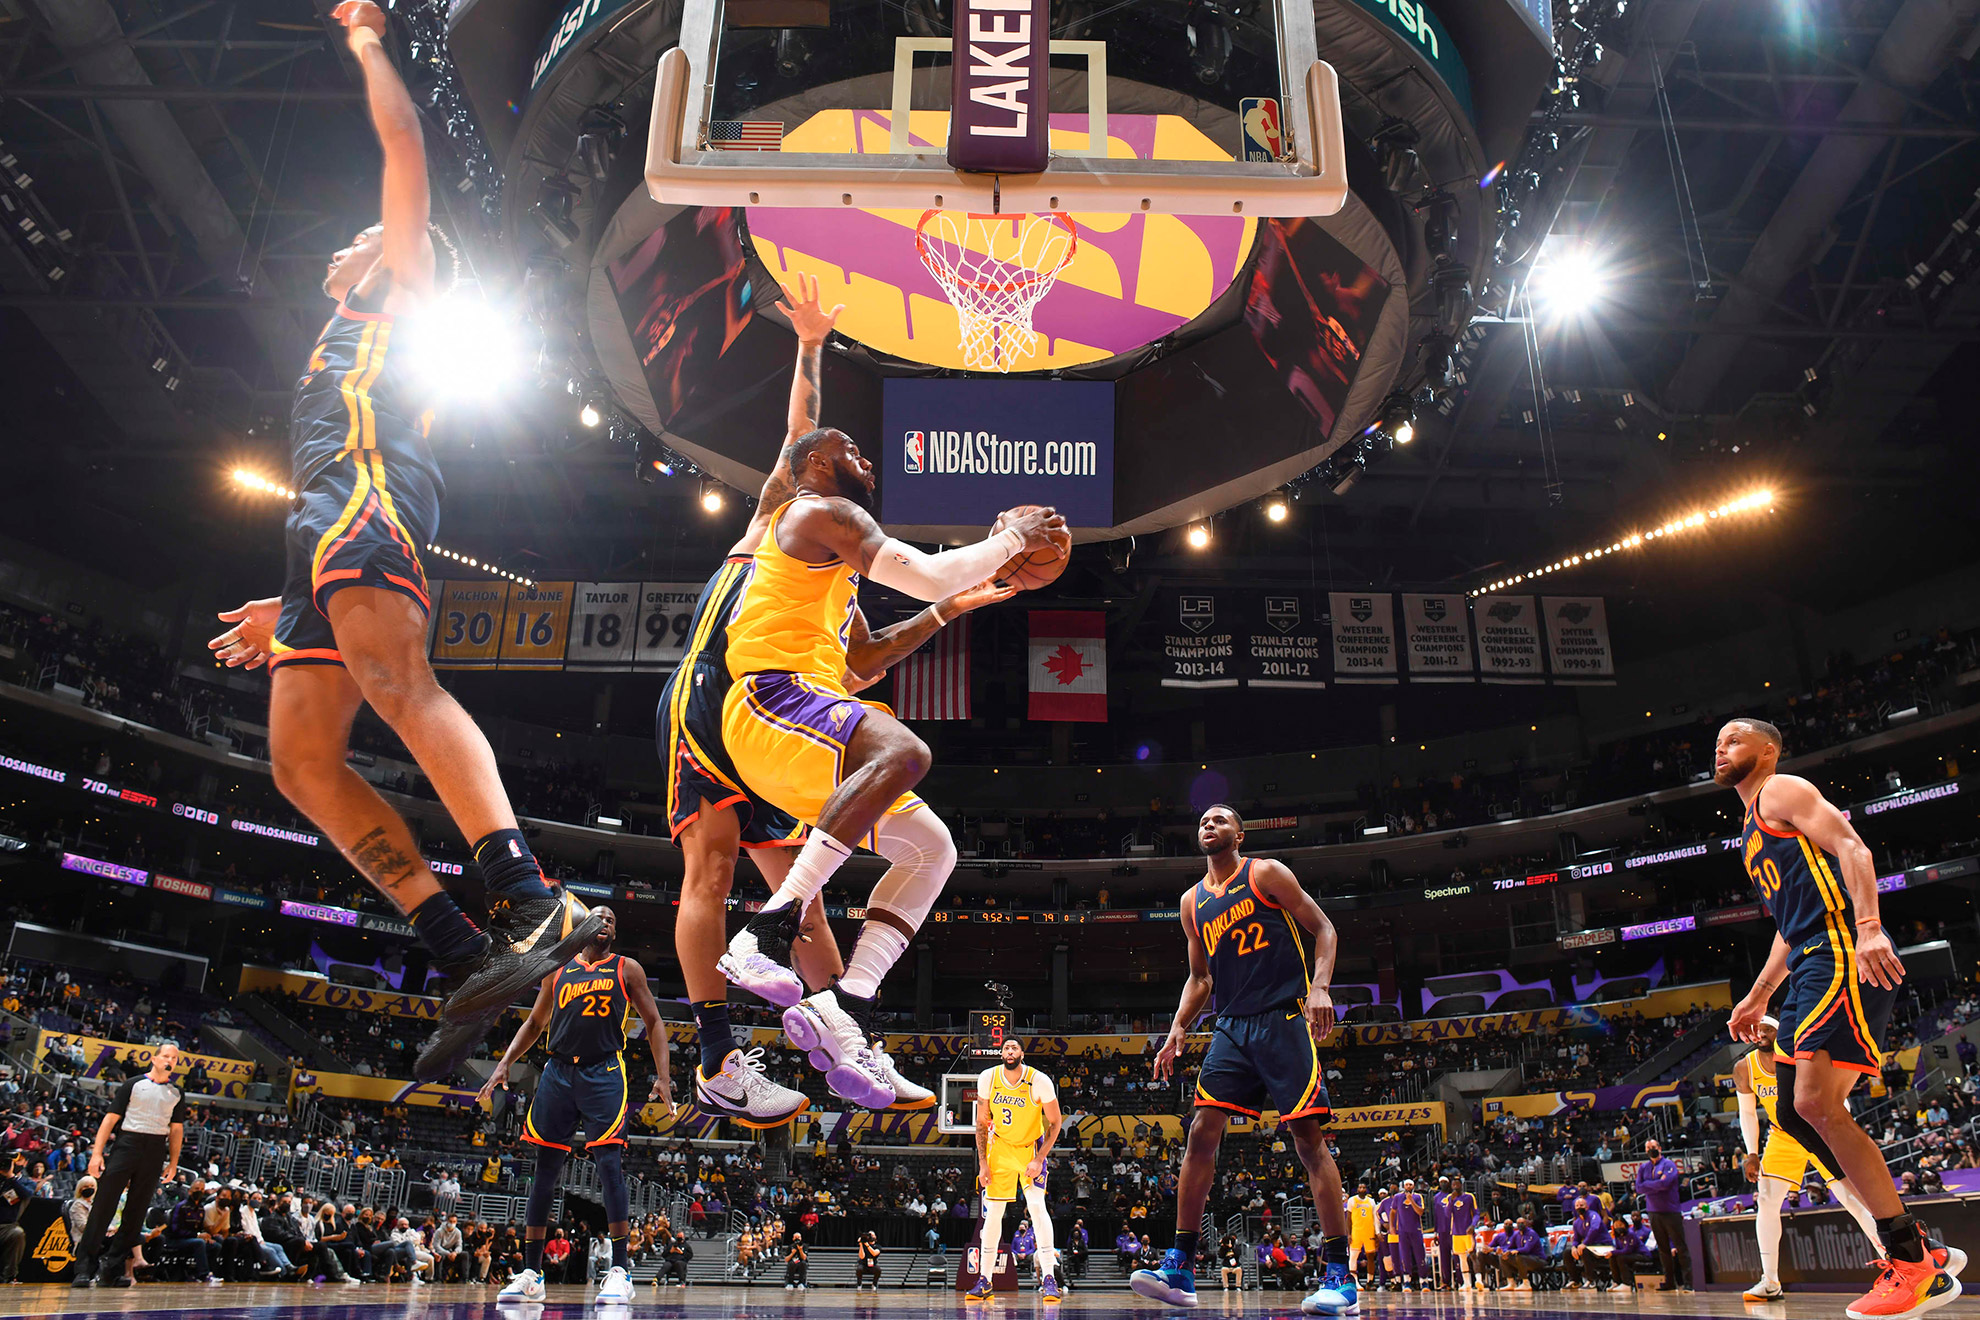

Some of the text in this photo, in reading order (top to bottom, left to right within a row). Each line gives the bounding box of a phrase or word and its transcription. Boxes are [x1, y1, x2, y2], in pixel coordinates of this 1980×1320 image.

[929, 430, 1097, 476] NBAStore.com
[452, 590, 499, 602] VACHON
[517, 591, 563, 602] DIONNE
[585, 592, 629, 603] TAYLOR
[646, 592, 700, 603] GRETZKY
[1182, 599, 1211, 612] LA
[1269, 599, 1297, 612] LA
[1350, 600, 1371, 609] LA
[1424, 600, 1444, 609] LA
[443, 611, 495, 646] 30
[514, 611, 553, 647] 16
[582, 613, 622, 648] 18
[645, 613, 693, 648] 99
[1342, 625, 1383, 634] WESTERN
[1416, 625, 1458, 633] WESTERN
[1485, 626, 1529, 635] CAMPBELL
[1561, 628, 1594, 636] SMYTHE
[1164, 634, 1232, 647] STANLEY CUP
[1250, 635, 1318, 646] STANLEY CUP
[1336, 635, 1390, 644] CONFERENCE
[1410, 634, 1466, 643] CONFERENCE
[1481, 636, 1536, 645] CONFERENCE
[1560, 637, 1598, 646] DIVISION
[1165, 645, 1233, 658] CHAMPIONS
[1251, 646, 1319, 659] CHAMPIONS
[1339, 645, 1389, 654] CHAMPIONS
[1414, 644, 1465, 652] CHAMPIONS
[1485, 645, 1534, 654] CHAMPIONS
[1556, 646, 1605, 656] CHAMPIONS
[1346, 657, 1384, 667] 2013-14
[1423, 655, 1458, 666] 2011-12
[1491, 657, 1531, 667] 1992-93
[1563, 659, 1601, 669] 1990-91
[1174, 661, 1225, 676] 2013-14
[1262, 661, 1310, 676] 2011-12
[0, 754, 66, 782] LOSANGELES
[82, 777, 108, 794] 710
[120, 789, 158, 808] ESPN
[1864, 782, 1960, 815] @ESPNLOSANGELES
[231, 819, 319, 846] @ESPNLOSANGELES
[1624, 844, 1708, 869] @ESPNLOSANGELES
[70, 858, 132, 881] ANGELES
[1939, 865, 1965, 875] TOYOTA
[1492, 878, 1514, 891] 710
[1526, 872, 1558, 886] ESPN
[1752, 857, 1781, 900] 30
[155, 876, 211, 898] TOSHIBA
[566, 884, 589, 892] AMERICAN
[590, 887, 611, 895] EXPRESS
[1424, 885, 1470, 900] Spectrum
[223, 892, 266, 907] BUD LIGHT
[289, 904, 344, 923] ANGELES
[934, 912, 948, 922] 83
[982, 912, 1003, 923] 9:52
[1042, 913, 1054, 922] 79
[377, 921, 414, 934] DELTA
[1203, 897, 1255, 957] OAKLAND
[1629, 919, 1683, 938] ANGELES
[1231, 922, 1270, 956] 22
[1563, 929, 1614, 949] STAPLES
[297, 979, 373, 1011] LOS
[558, 978, 615, 1010] OAKLAND
[581, 994, 612, 1017] 23
[982, 1014, 1006, 1027] 9:52
[991, 1026, 1003, 1046] 9
[896, 1035, 1071, 1056] ANGES
[1756, 1083, 1778, 1097] LAK
[993, 1092, 1026, 1108] LAKERS
[1489, 1102, 1499, 1111] 117
[1002, 1107, 1012, 1126] 3
[1342, 1107, 1432, 1123] ANGELES
[1361, 1208, 1367, 1217] 2
[1717, 1232, 1741, 1273] NBA
[1785, 1226, 1813, 1271] The
[1814, 1223, 1875, 1271] Official
